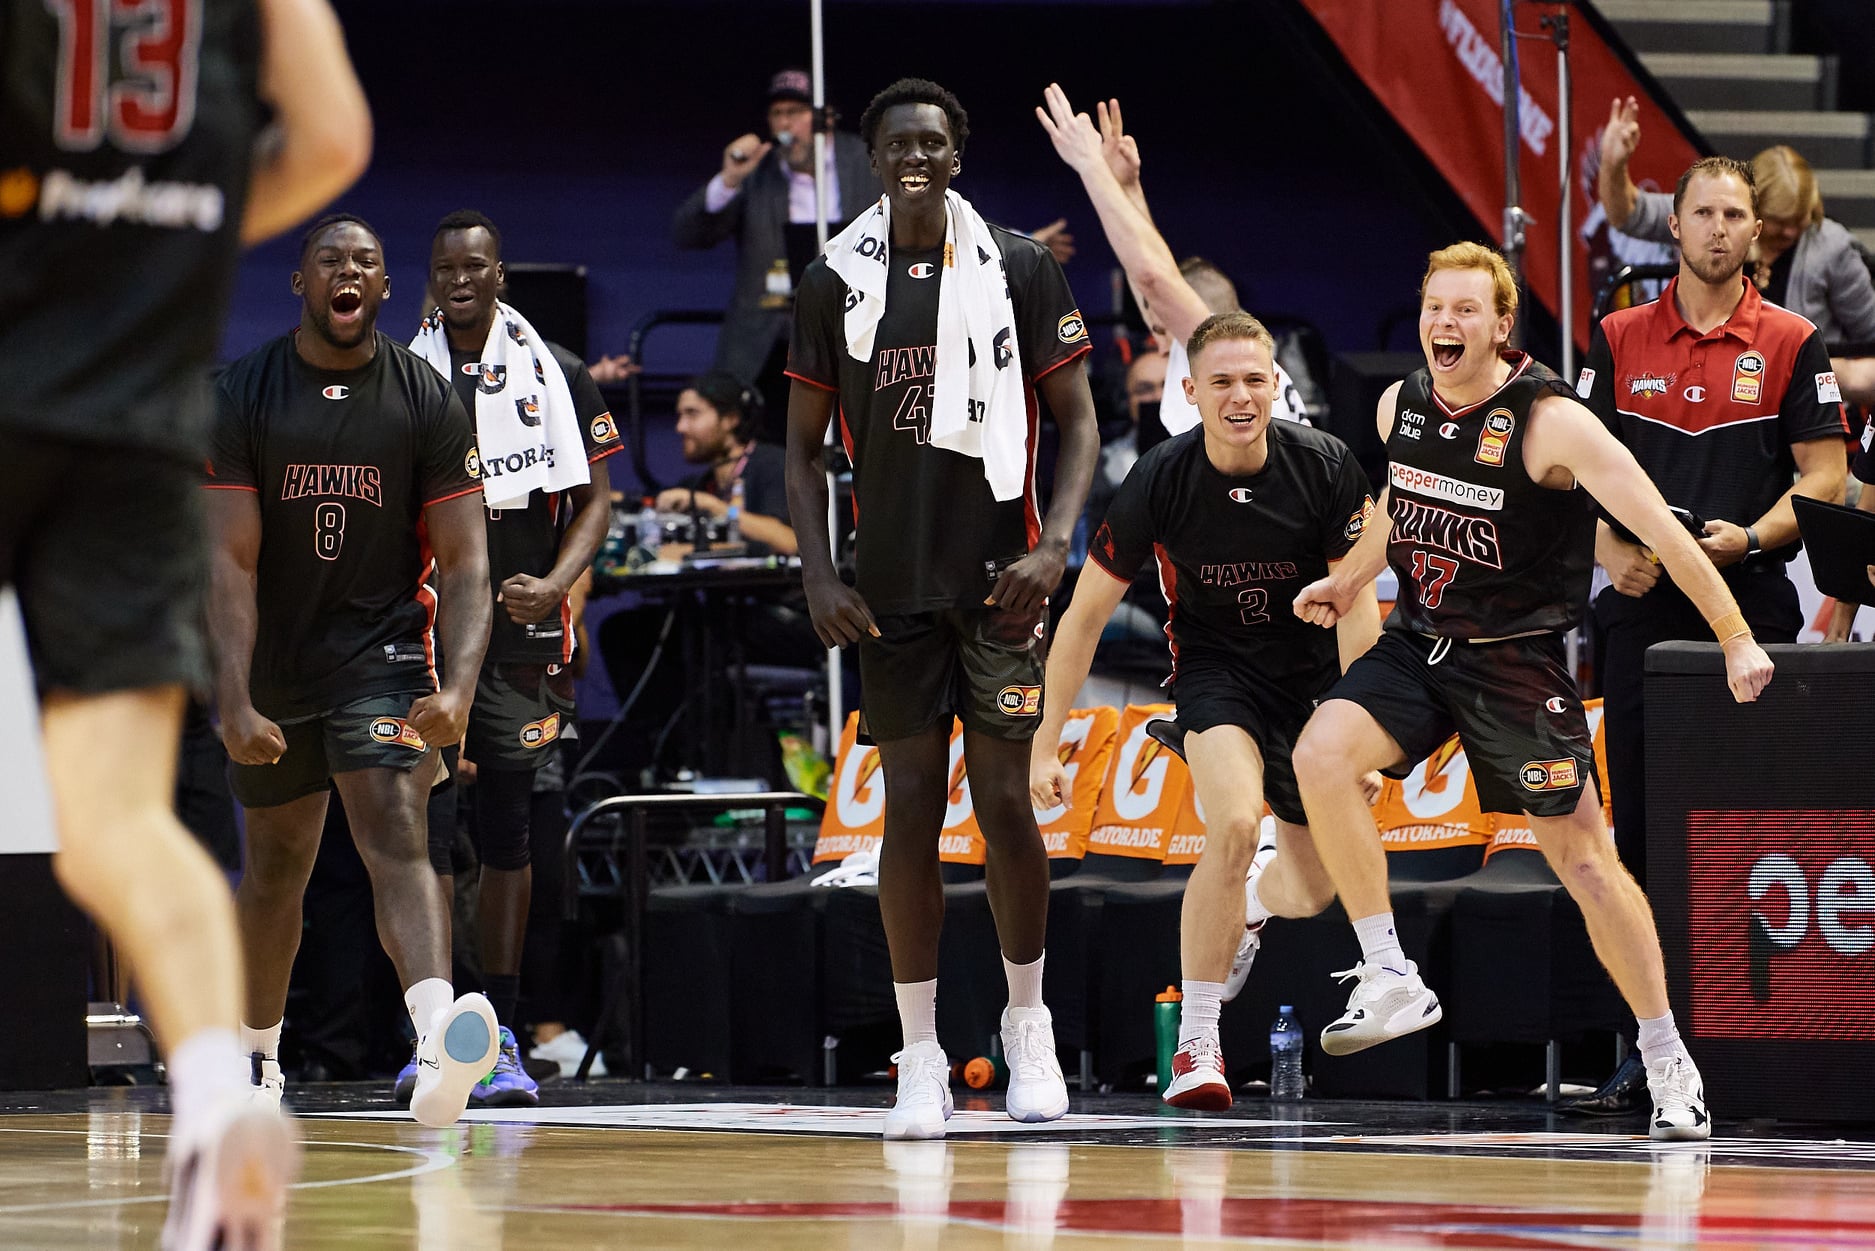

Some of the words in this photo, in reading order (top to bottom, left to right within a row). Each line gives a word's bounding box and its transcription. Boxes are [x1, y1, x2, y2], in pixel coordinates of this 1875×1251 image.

[44, 0, 203, 152] 13
[875, 346, 938, 391] HAW
[1742, 358, 1758, 370] NBL
[1631, 379, 1667, 394] HAWKS
[894, 385, 936, 444] 4
[1401, 408, 1426, 426] dkm
[1492, 416, 1509, 431] NBL
[1399, 423, 1422, 440] blue
[281, 464, 382, 507] HAWKS
[315, 502, 346, 560] 8
[1390, 498, 1502, 570] HAWKS
[1200, 561, 1299, 587] HAWKS
[1411, 550, 1460, 609] 17
[1238, 588, 1270, 625] 2
[1003, 693, 1019, 706] NBL
[377, 723, 395, 736] NBL
[1527, 770, 1544, 782] NBL
